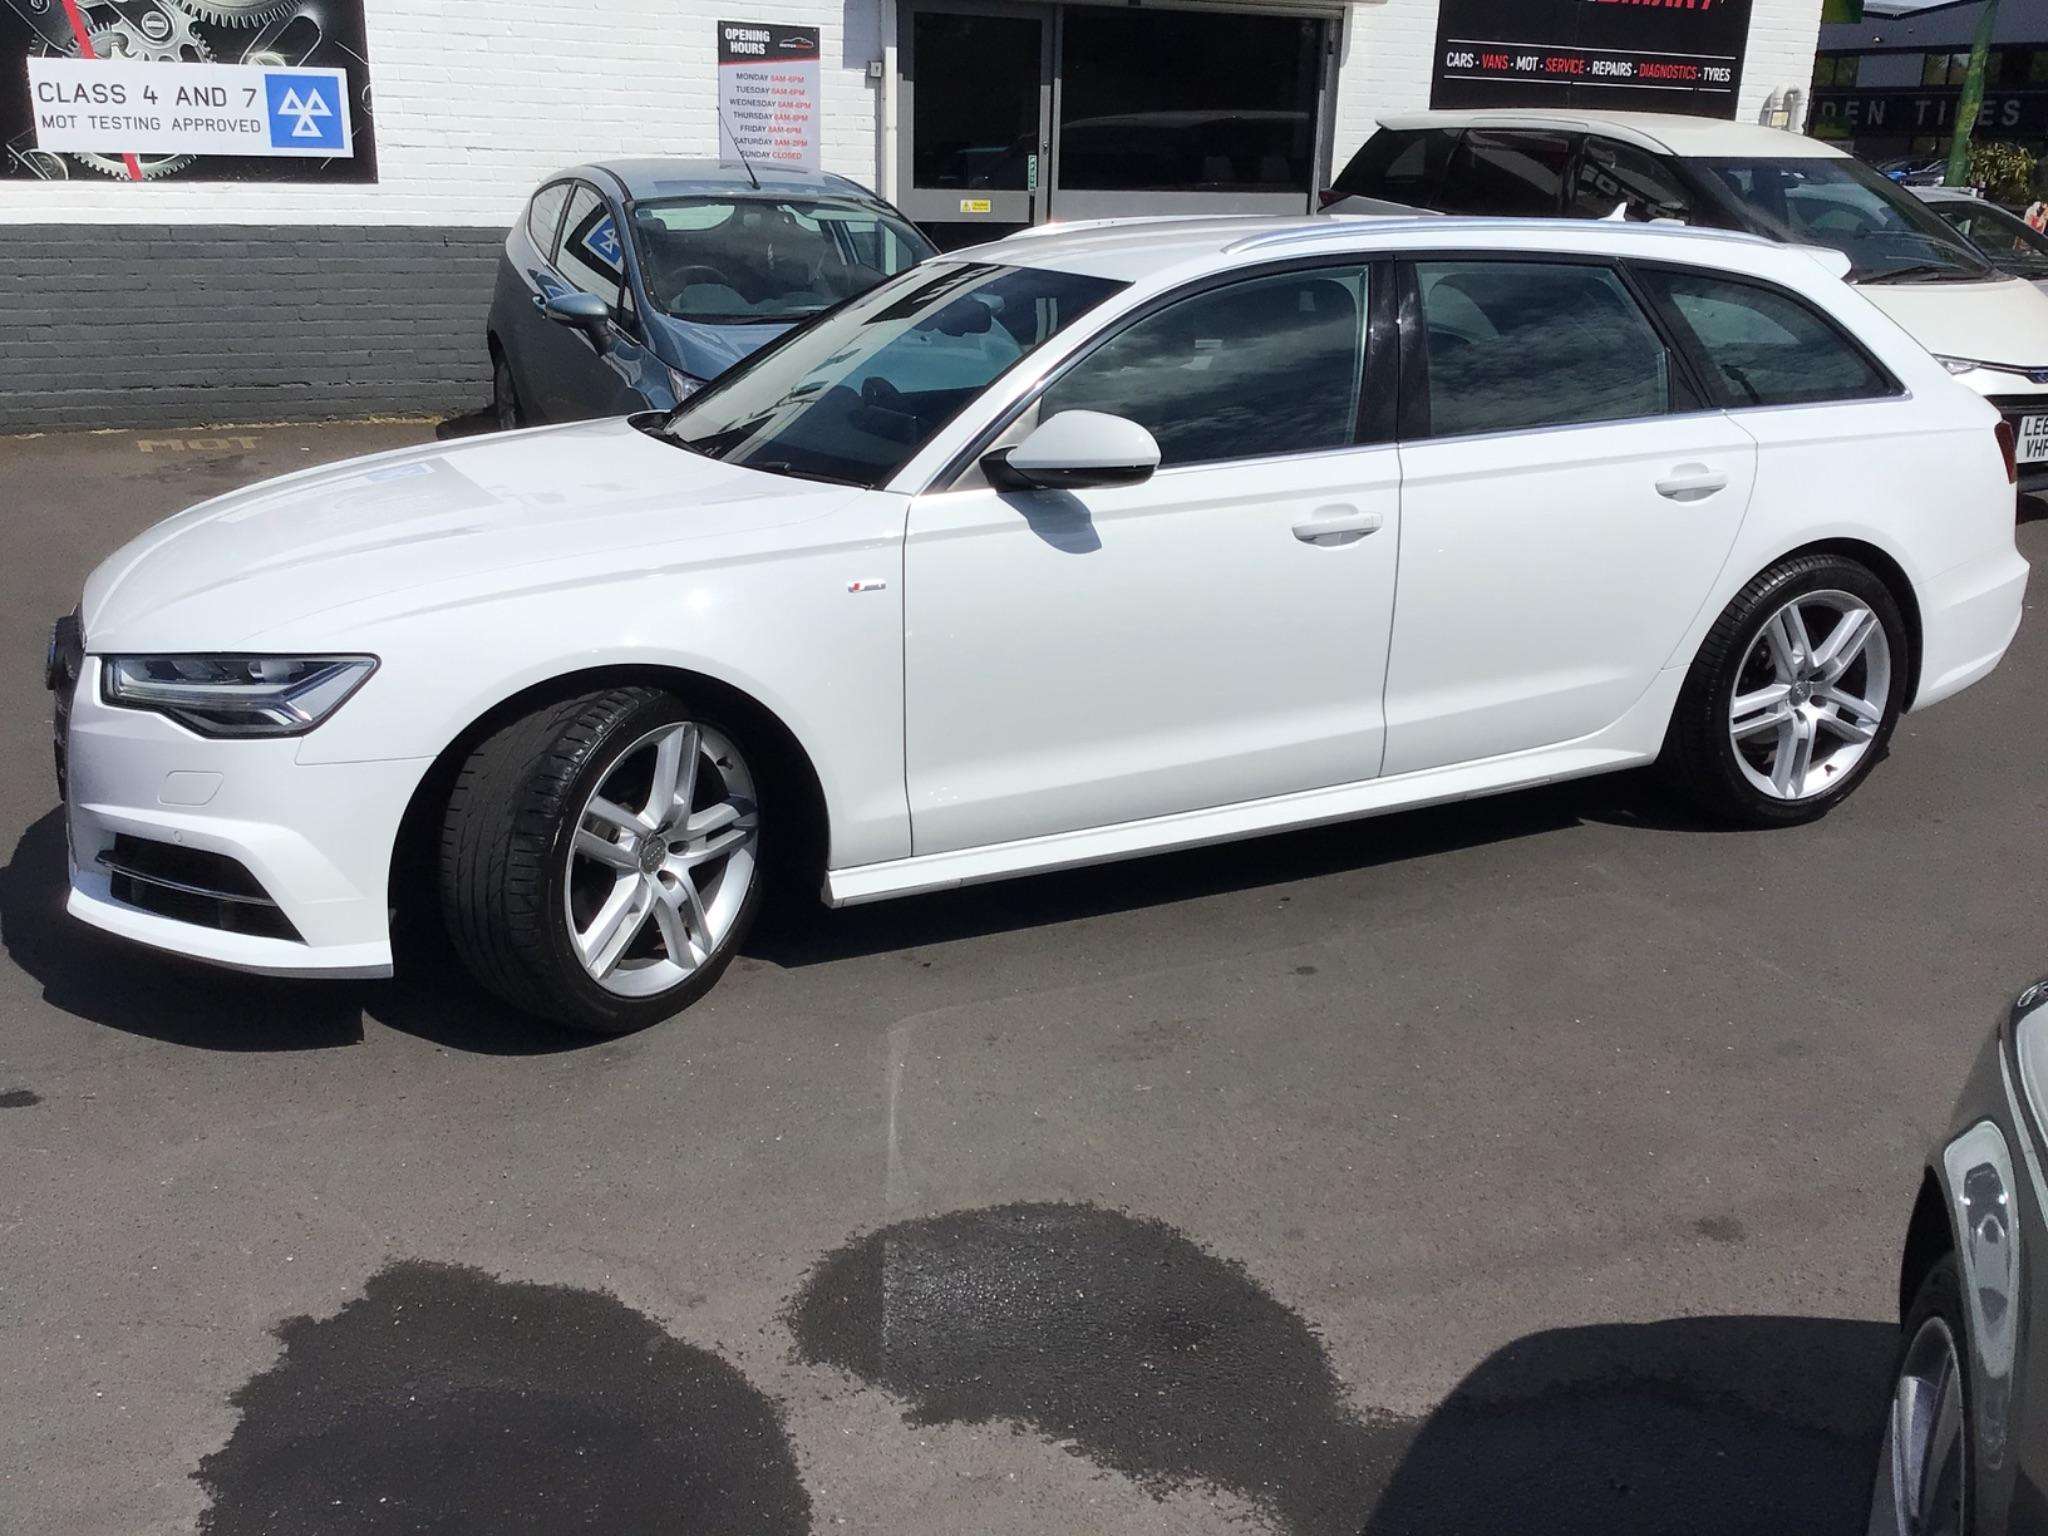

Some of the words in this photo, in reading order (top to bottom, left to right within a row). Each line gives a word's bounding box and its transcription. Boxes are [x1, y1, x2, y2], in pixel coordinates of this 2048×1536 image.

[724, 28, 771, 41] OPENING
[730, 42, 766, 55] HOURS
[1446, 52, 1474, 68] CARS
[1481, 53, 1509, 70] VANS
[1515, 55, 1540, 72] MOT
[1545, 57, 1585, 75] SERVICE
[1592, 61, 1633, 77] REPAIRS
[1638, 64, 1698, 80] DIAGNOSTICS
[1703, 66, 1732, 83] TYRES
[736, 73, 769, 81] MONDAY
[736, 85, 770, 94] TUESDAY
[37, 82, 128, 105] CLASS
[142, 85, 159, 106] 4
[175, 86, 228, 108] AND
[241, 88, 258, 108] 7
[729, 98, 777, 107] WEDNESDAY
[733, 111, 773, 120] THURSDAY
[42, 115, 77, 129] MOT
[88, 116, 161, 131] TESTING
[171, 118, 261, 133] APPROVED
[740, 125, 767, 133] FRIDAY
[734, 137, 773, 146] SATURDAY
[740, 151, 770, 159] SUNDAY
[771, 152, 802, 160] CLOSED
